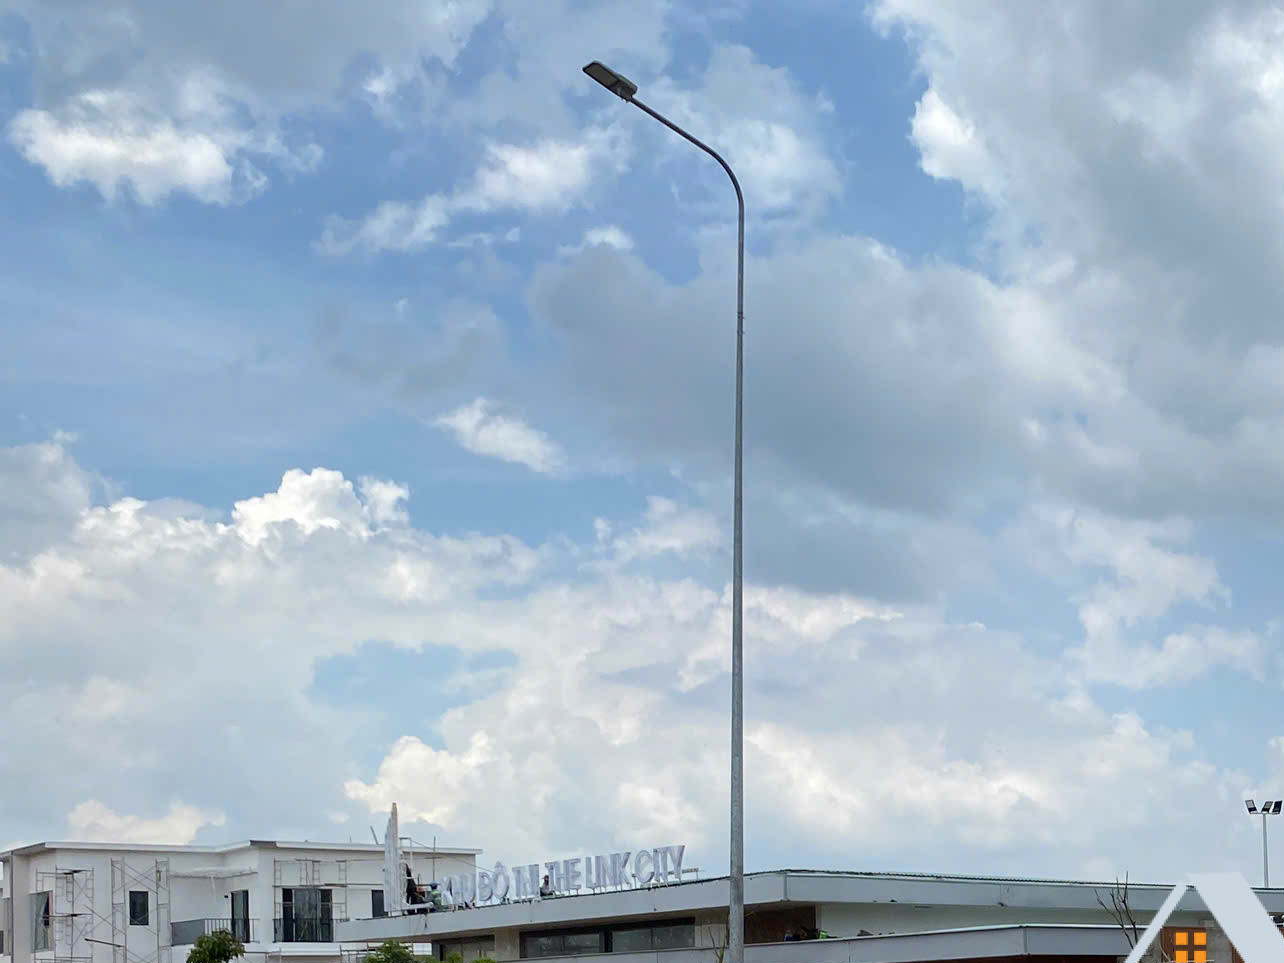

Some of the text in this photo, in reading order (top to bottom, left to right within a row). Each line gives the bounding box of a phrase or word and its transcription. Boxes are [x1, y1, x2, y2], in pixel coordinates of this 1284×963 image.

[545, 859, 582, 891] THE
[585, 852, 632, 888] LINK
[635, 846, 686, 883] CITY
